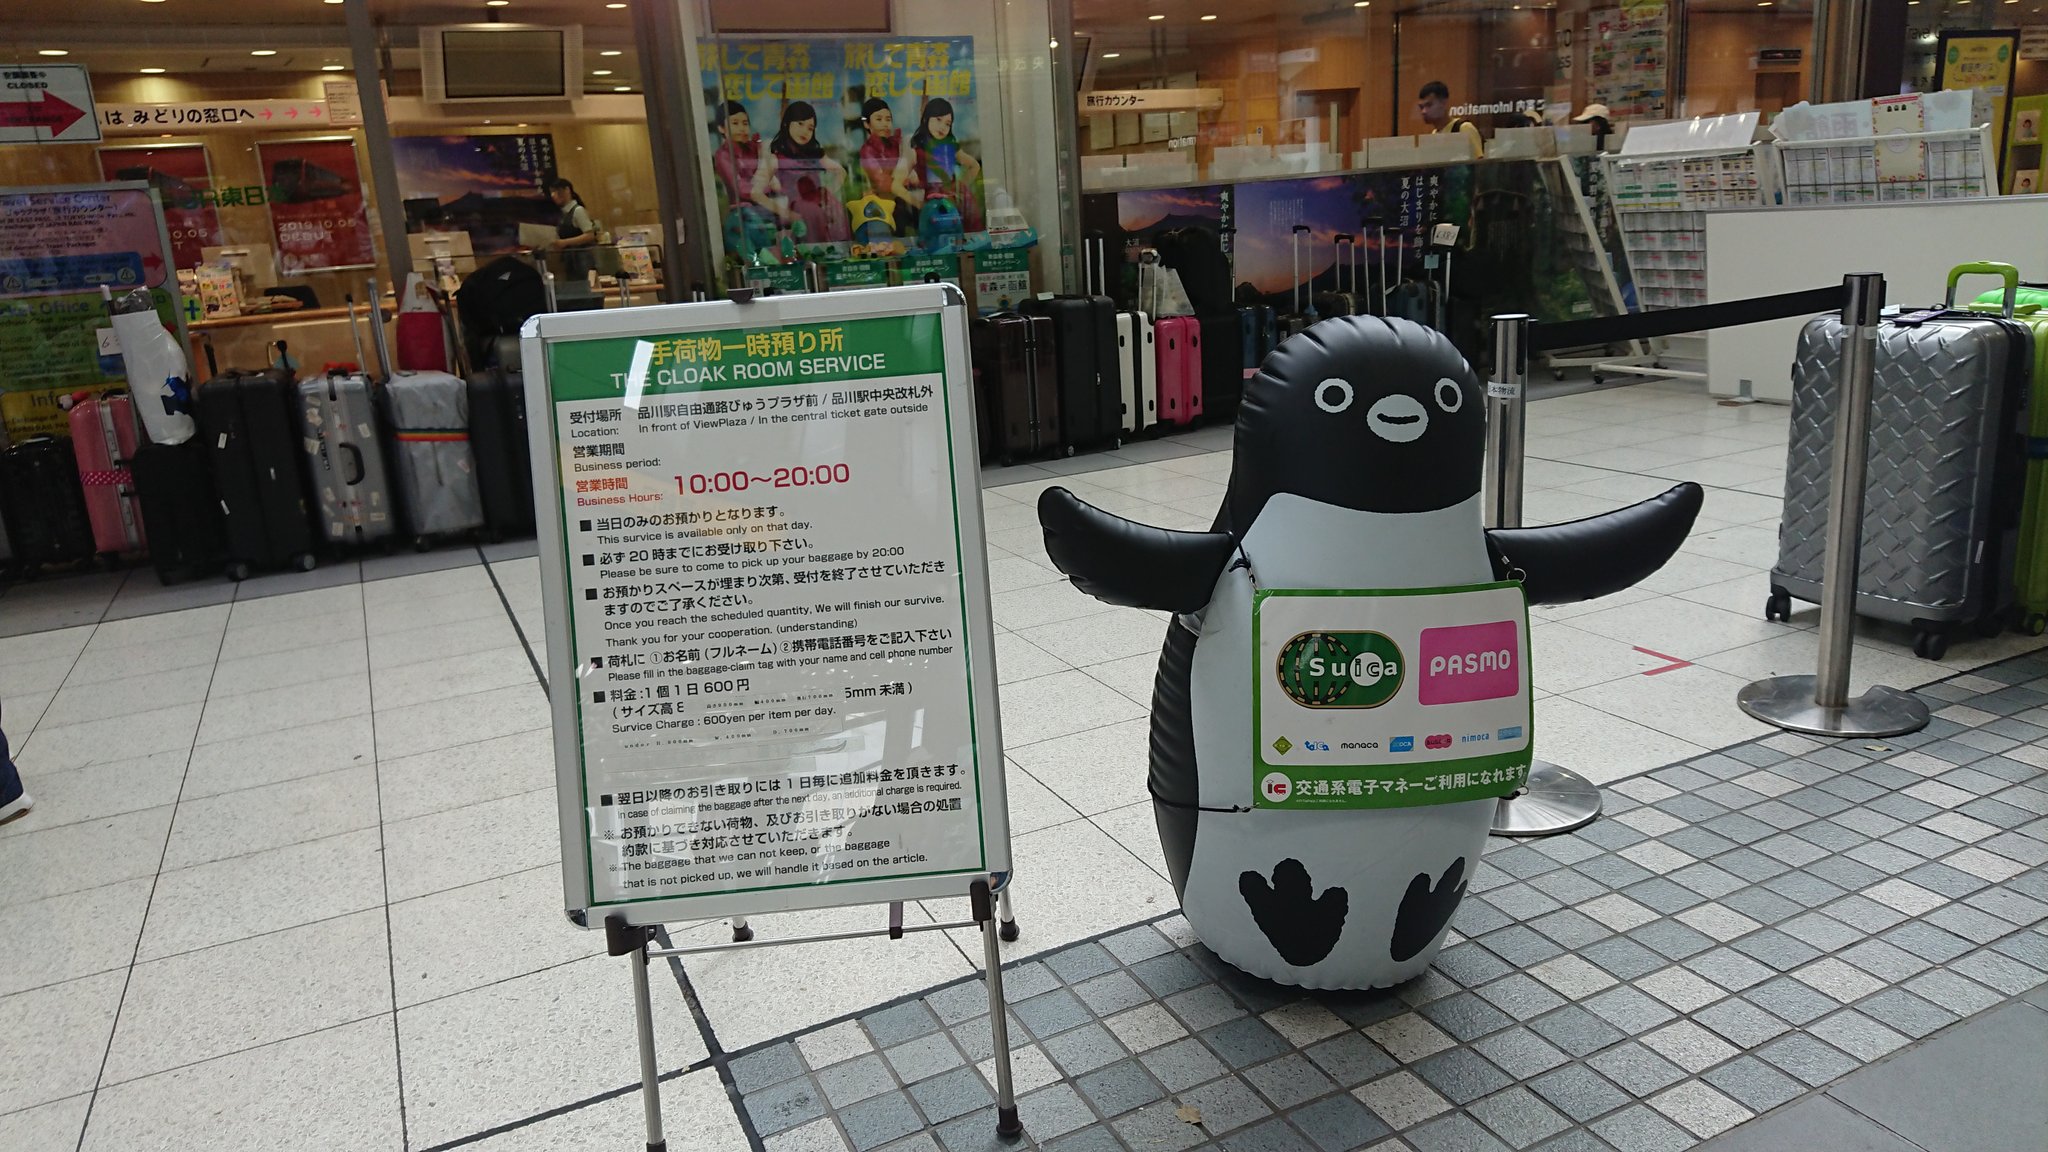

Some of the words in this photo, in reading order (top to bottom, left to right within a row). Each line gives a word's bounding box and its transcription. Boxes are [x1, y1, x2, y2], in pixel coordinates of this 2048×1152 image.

[1086, 95, 1145, 107] 旅行カウンター
[651, 326, 844, 366] 手荷物一時預り所
[655, 364, 727, 386] CLOAK
[732, 359, 793, 380] ROOM
[798, 352, 886, 375] SERVICE
[569, 407, 622, 425] 受付場所
[636, 392, 819, 420] 品川駅自由通路びゅうプラザ前
[830, 384, 934, 405] 品川駅中央改札外
[570, 425, 619, 438] Location:
[638, 423, 648, 433] In
[650, 421, 677, 432] front
[679, 420, 690, 430] of
[692, 416, 747, 429] ViewPlaza
[757, 414, 768, 424] In
[770, 413, 788, 424] the
[790, 410, 827, 422] central
[830, 407, 861, 419] ticket
[863, 406, 888, 417] gate
[889, 402, 928, 414] outside
[572, 441, 625, 459] 営業期間
[573, 459, 623, 473] Business
[625, 457, 661, 470] period:
[575, 476, 628, 493] 営業時間
[576, 493, 625, 507] Business
[628, 491, 663, 503] Hours:
[595, 503, 784, 532] 当日のみのお預かりとなります。
[596, 534, 620, 545] This
[622, 530, 662, 543] survice
[664, 529, 674, 540] is
[676, 526, 723, 539] available
[725, 524, 748, 536] only
[750, 524, 763, 533] on
[765, 521, 788, 532] that
[790, 519, 812, 531] day.
[599, 567, 636, 579] Please
[638, 566, 652, 576] be
[654, 565, 679, 575] sure
[681, 563, 693, 572] to
[695, 562, 724, 572] come
[727, 559, 739, 569] to
[741, 557, 763, 569] pick
[765, 557, 779, 567] up
[781, 555, 806, 566] your
[807, 550, 854, 564] baggage
[855, 548, 869, 560] by
[871, 545, 904, 558] 20:00
[603, 591, 753, 617] ますのでご了承ください。
[604, 619, 632, 630] Once
[634, 619, 654, 629] you
[656, 614, 687, 626] reach
[689, 613, 708, 623] the
[710, 608, 764, 622] scheduled
[814, 602, 831, 613] We
[833, 601, 851, 612] will
[853, 598, 881, 610] finish
[883, 599, 901, 608] our
[903, 593, 944, 606] survive.
[604, 636, 638, 647] Thank
[641, 635, 661, 645] you
[663, 632, 678, 643] for
[681, 632, 705, 642] your
[707, 625, 773, 640] cooperation.
[775, 618, 858, 634] (understanding)
[607, 670, 641, 682] Please
[642, 668, 654, 679] fill
[656, 668, 665, 677] in
[667, 666, 684, 677] the
[684, 660, 755, 677] baggage-claim
[757, 659, 774, 670] tag
[775, 657, 796, 667] with
[798, 656, 820, 667] your
[822, 654, 848, 664] name
[849, 651, 867, 662] and
[868, 649, 885, 660] cell
[887, 647, 916, 659] phone
[918, 644, 953, 656] number
[1309, 657, 1398, 678] Suica
[1430, 649, 1511, 677] PASMO
[611, 720, 652, 733] Survice
[655, 717, 694, 730] Charge
[703, 712, 745, 726] 600yen
[747, 712, 766, 722] per
[768, 708, 791, 719] item
[794, 708, 812, 718] per
[813, 705, 836, 717] day.
[1340, 741, 1379, 750] manaca
[1461, 732, 1490, 743] nimoca
[627, 809, 649, 819] case
[660, 804, 695, 817] claiming
[697, 802, 712, 812] the
[713, 798, 751, 812] baggage
[752, 796, 774, 807] after
[774, 794, 790, 805] the
[790, 792, 812, 804] next
[844, 786, 884, 799] additional
[884, 784, 915, 797] charge
[925, 780, 962, 793] required.
[619, 860, 642, 872] The
[644, 856, 691, 870] baggage
[693, 854, 716, 865] that
[736, 851, 756, 861] can
[758, 848, 776, 859] not
[778, 845, 807, 858] keep,
[824, 842, 842, 854] the
[844, 838, 890, 852] baggage
[622, 878, 645, 889] that
[647, 876, 657, 887] is
[659, 875, 677, 885] not
[679, 871, 715, 884] picked
[717, 871, 734, 881] up,
[736, 869, 752, 878] we
[754, 866, 771, 877] will
[774, 862, 809, 875] handle
[811, 861, 819, 871] it
[821, 857, 854, 871] based
[856, 859, 869, 867] on
[871, 855, 890, 866] the
[892, 852, 927, 864] article.
